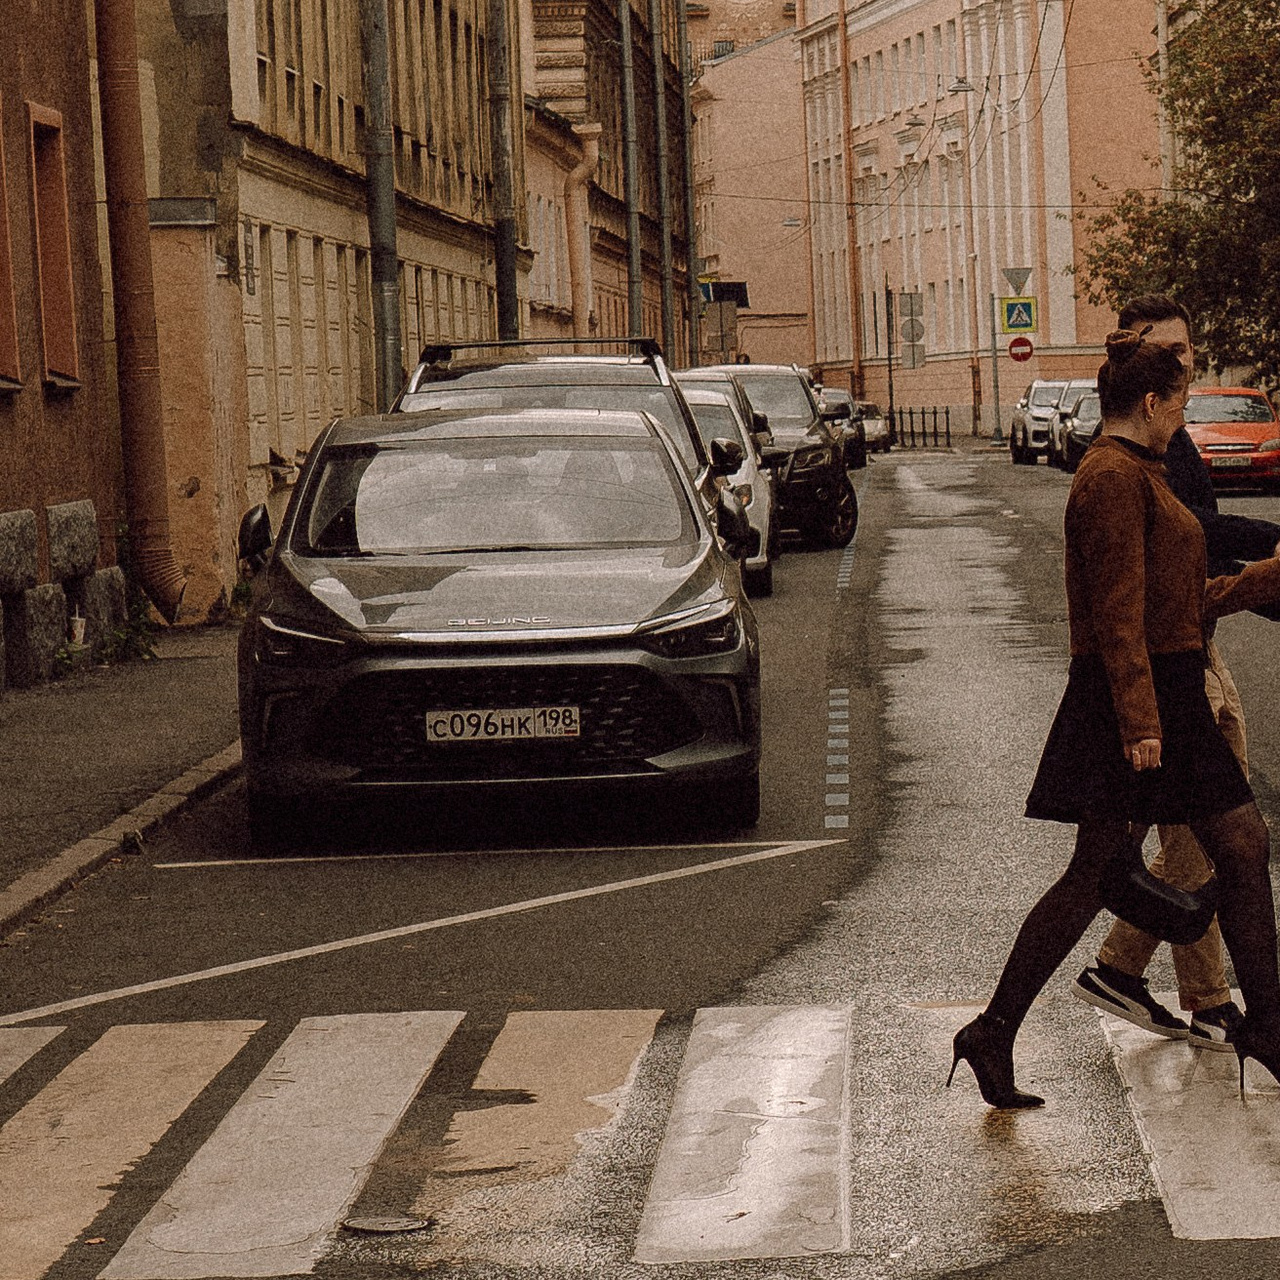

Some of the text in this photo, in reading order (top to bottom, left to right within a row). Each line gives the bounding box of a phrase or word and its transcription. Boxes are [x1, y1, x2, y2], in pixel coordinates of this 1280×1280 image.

[447, 616, 551, 627] BEIJING
[433, 709, 573, 738] С096НК 198
[545, 727, 564, 735] RUS
